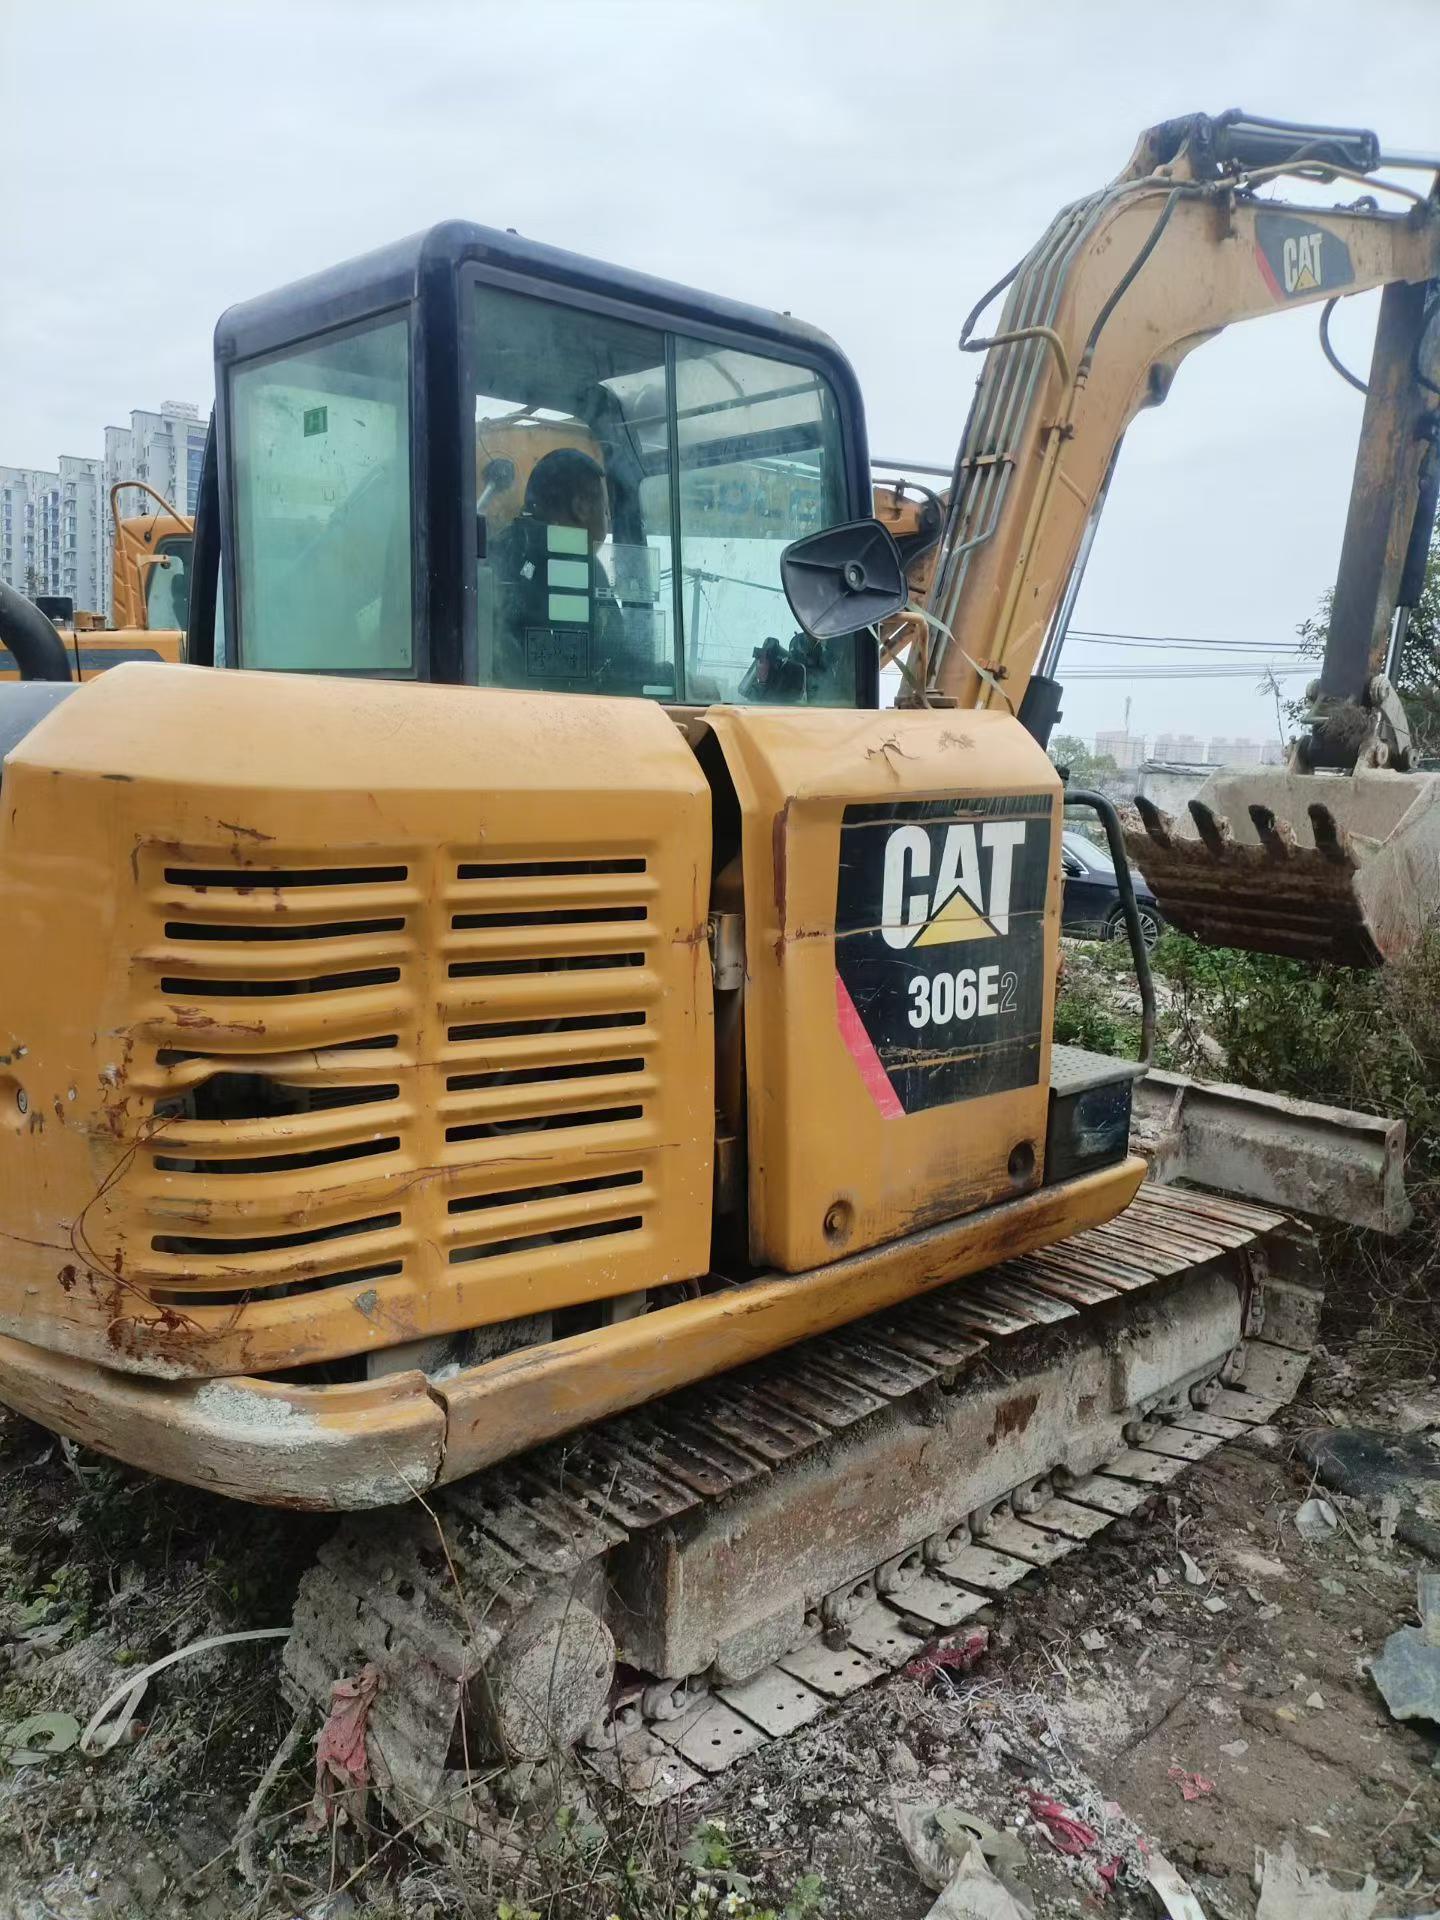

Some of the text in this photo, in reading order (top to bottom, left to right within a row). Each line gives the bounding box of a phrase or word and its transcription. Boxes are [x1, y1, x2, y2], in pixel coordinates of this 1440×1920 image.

[1283, 233, 1323, 292] CAT
[881, 821, 1026, 949] CAT
[908, 965, 1018, 1028] 306E2
